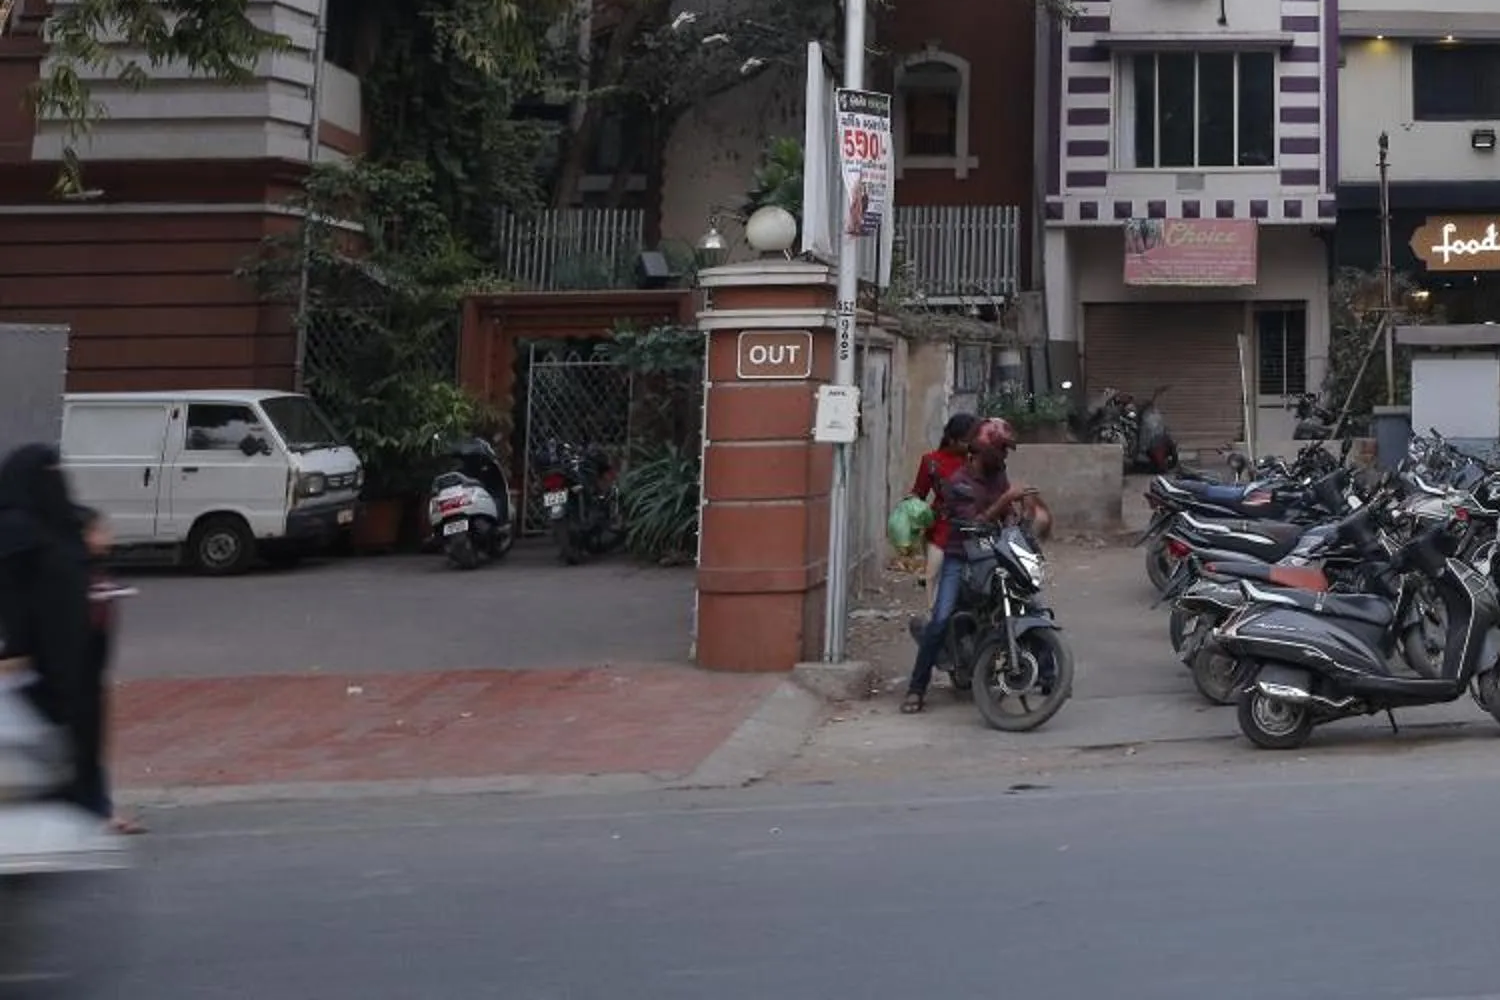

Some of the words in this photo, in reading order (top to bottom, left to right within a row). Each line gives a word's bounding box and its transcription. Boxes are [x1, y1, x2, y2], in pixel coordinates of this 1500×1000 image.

[1165, 222, 1238, 248] Choice
[1431, 222, 1498, 264] food
[749, 344, 801, 365] OUT
